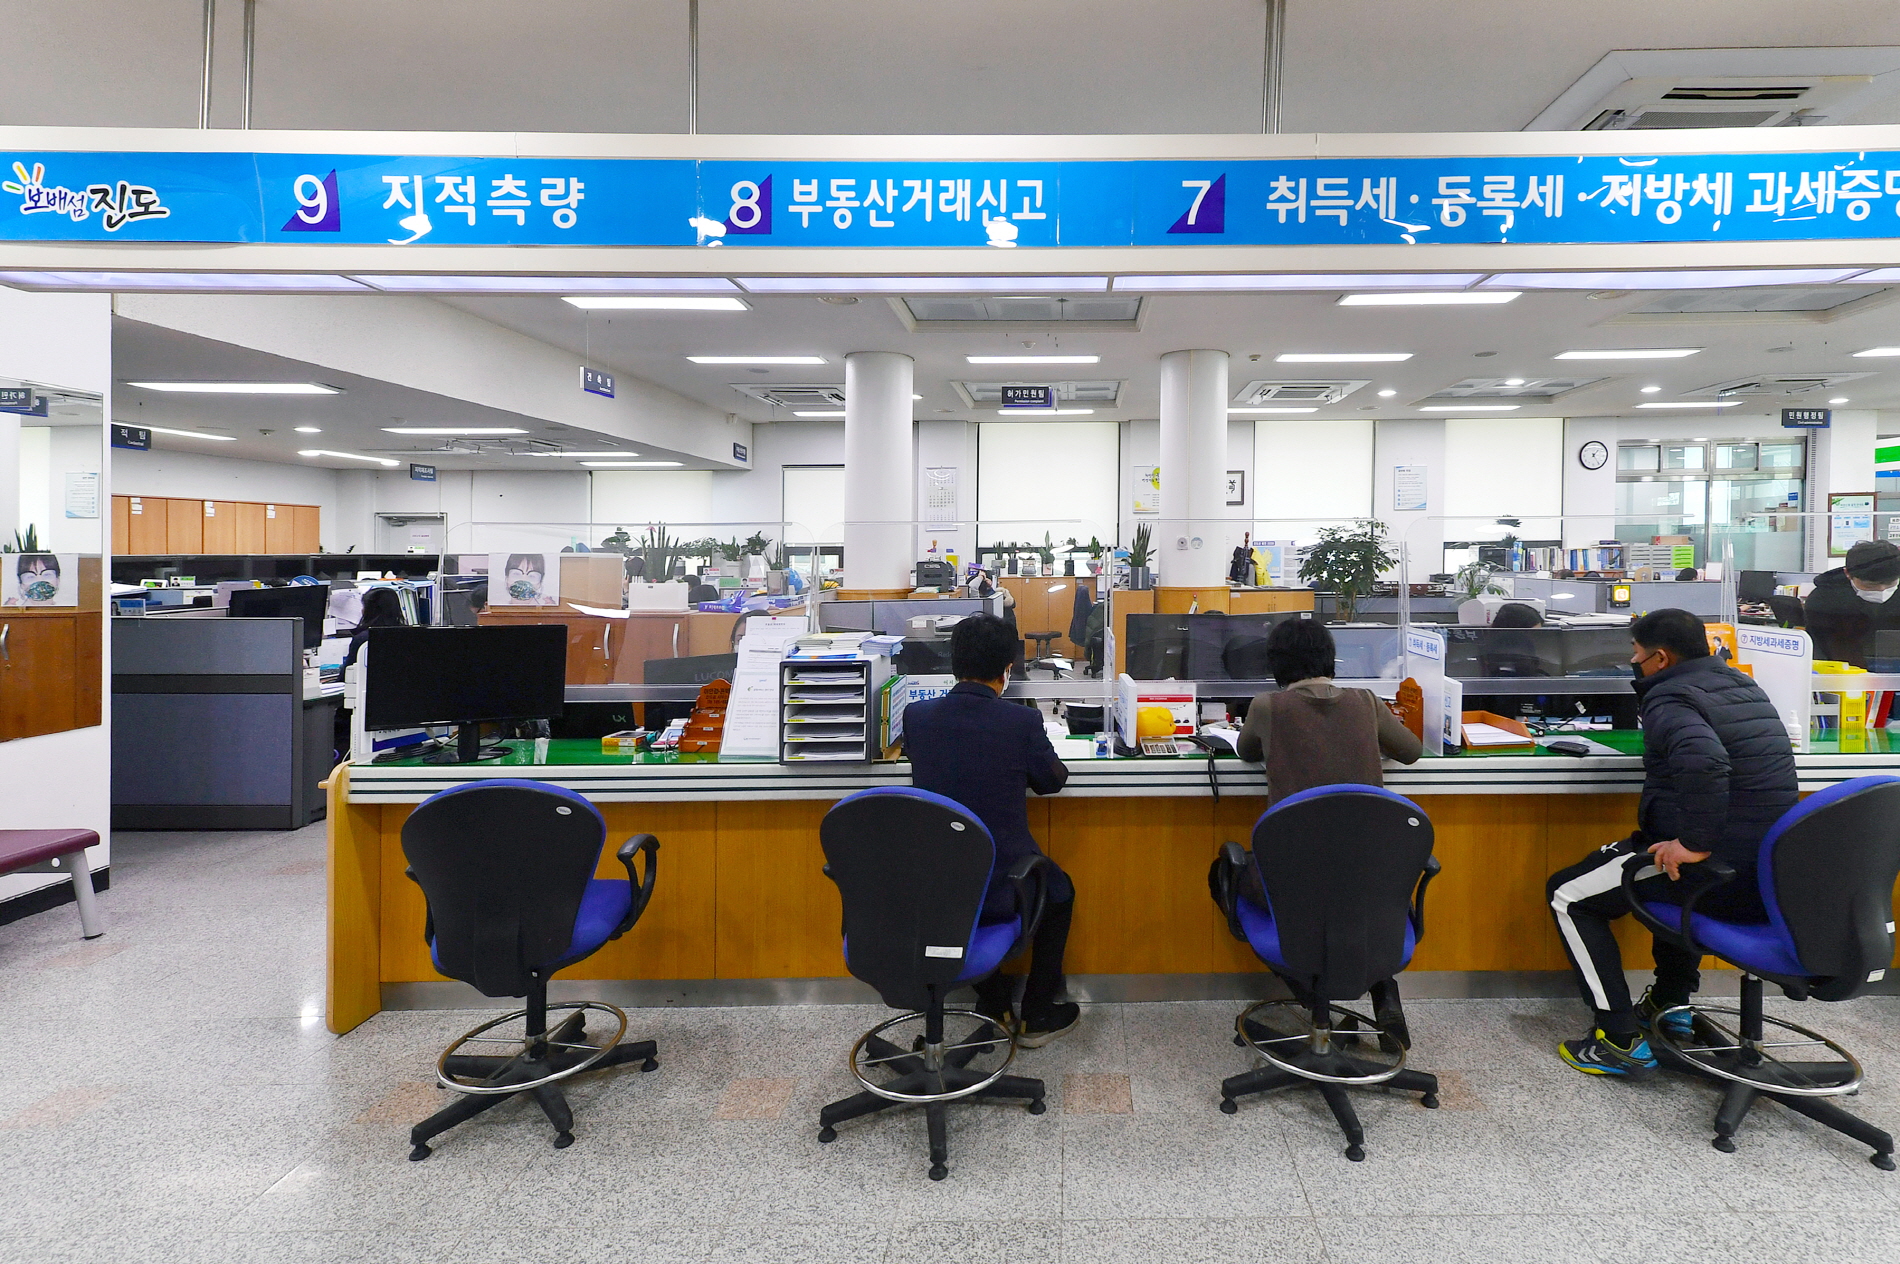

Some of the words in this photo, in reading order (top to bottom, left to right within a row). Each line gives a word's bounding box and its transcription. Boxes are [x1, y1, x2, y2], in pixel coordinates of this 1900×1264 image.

[23, 187, 86, 218] 보배섬
[90, 183, 167, 229] 진도
[296, 173, 328, 224] 9
[381, 173, 586, 228] 지적측량
[729, 179, 762, 229] 8
[788, 177, 1047, 229] 부동산거래신고
[1181, 179, 1212, 226] 7
[1600, 171, 1733, 225] 지방세
[1006, 388, 1045, 399] 허가민원팀
[1788, 411, 1824, 420] 민원행정팀
[1749, 635, 1800, 651] 지방세과세증명
[908, 688, 937, 700] 부동산
